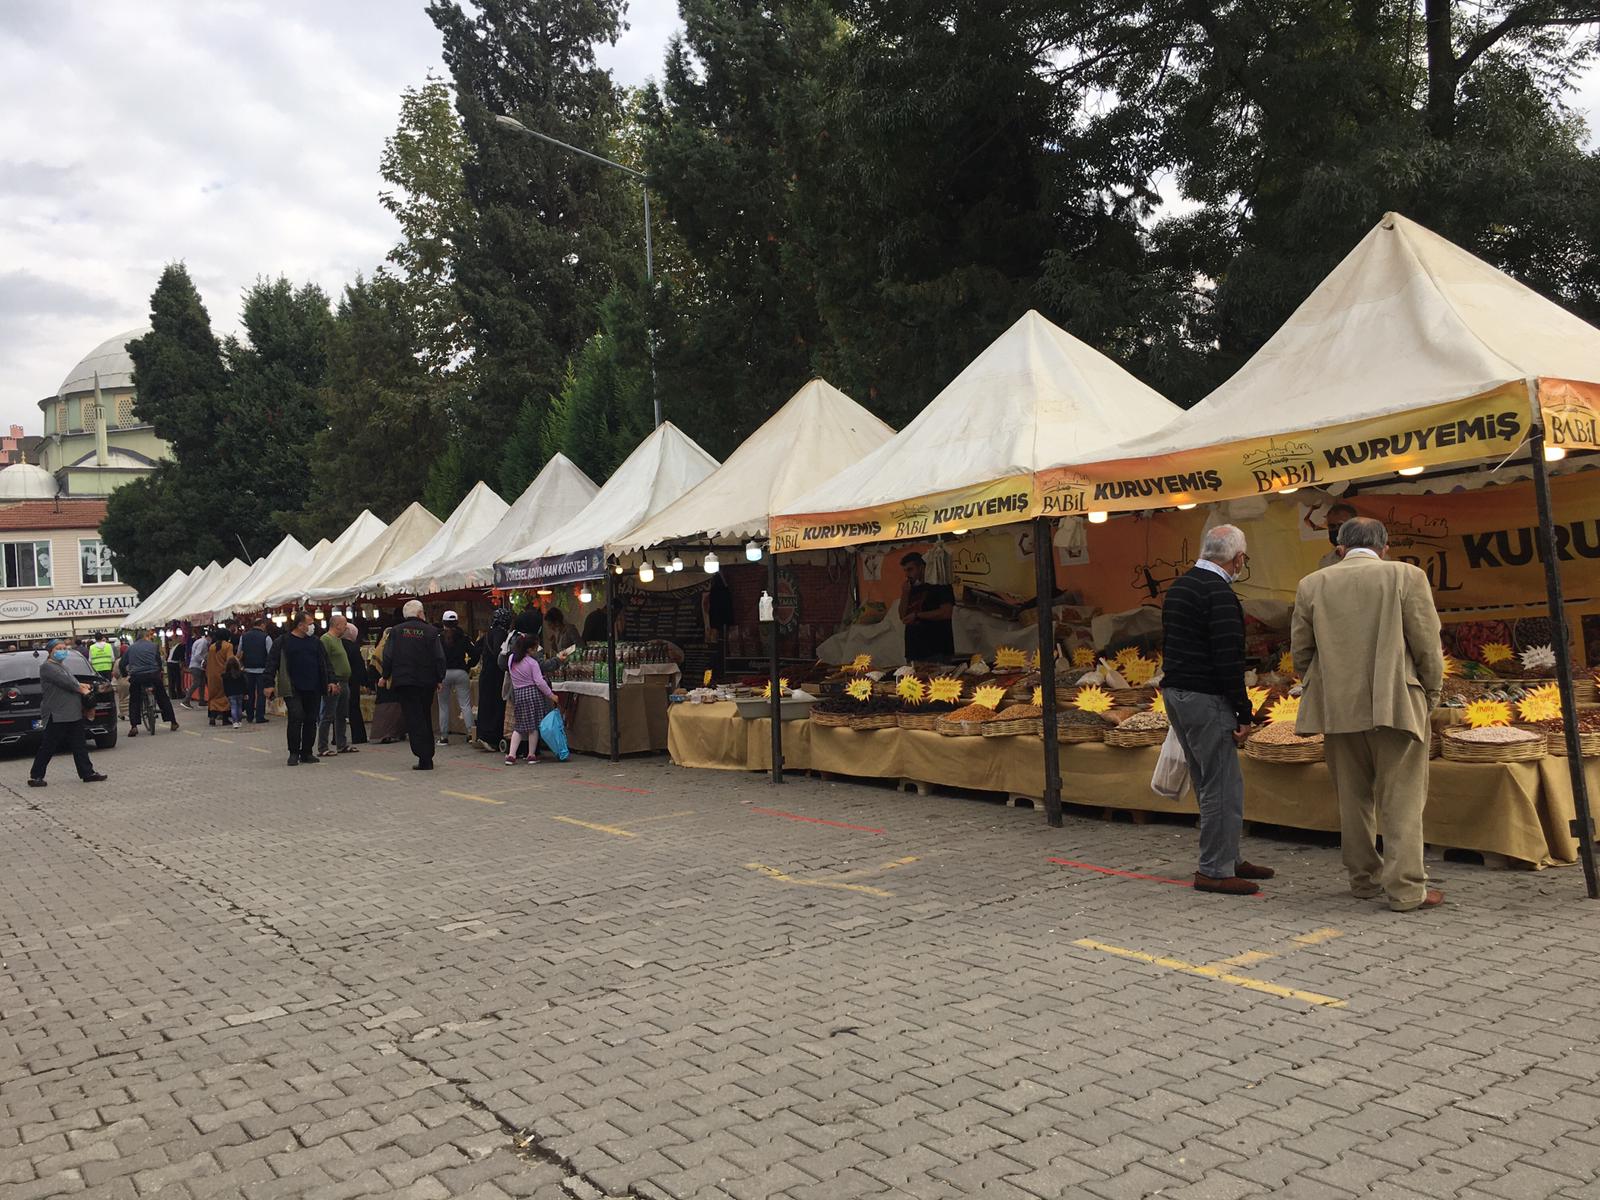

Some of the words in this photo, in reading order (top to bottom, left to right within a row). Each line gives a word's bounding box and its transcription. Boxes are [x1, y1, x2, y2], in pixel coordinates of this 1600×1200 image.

[1323, 412, 1521, 469] KURUYEMİŞ
[1093, 469, 1223, 501] KURUYEMİŞ
[1252, 460, 1324, 493] BABİL
[932, 492, 1029, 525] KURUYEMİŞ
[1041, 491, 1090, 514] BABİL
[802, 520, 882, 541] KURUYEMİŞ
[894, 517, 929, 539] BABİL
[774, 532, 801, 551] BABİL
[558, 556, 588, 576] KAHVESİ
[47, 598, 94, 611] SARAY
[99, 596, 137, 608] HALI
